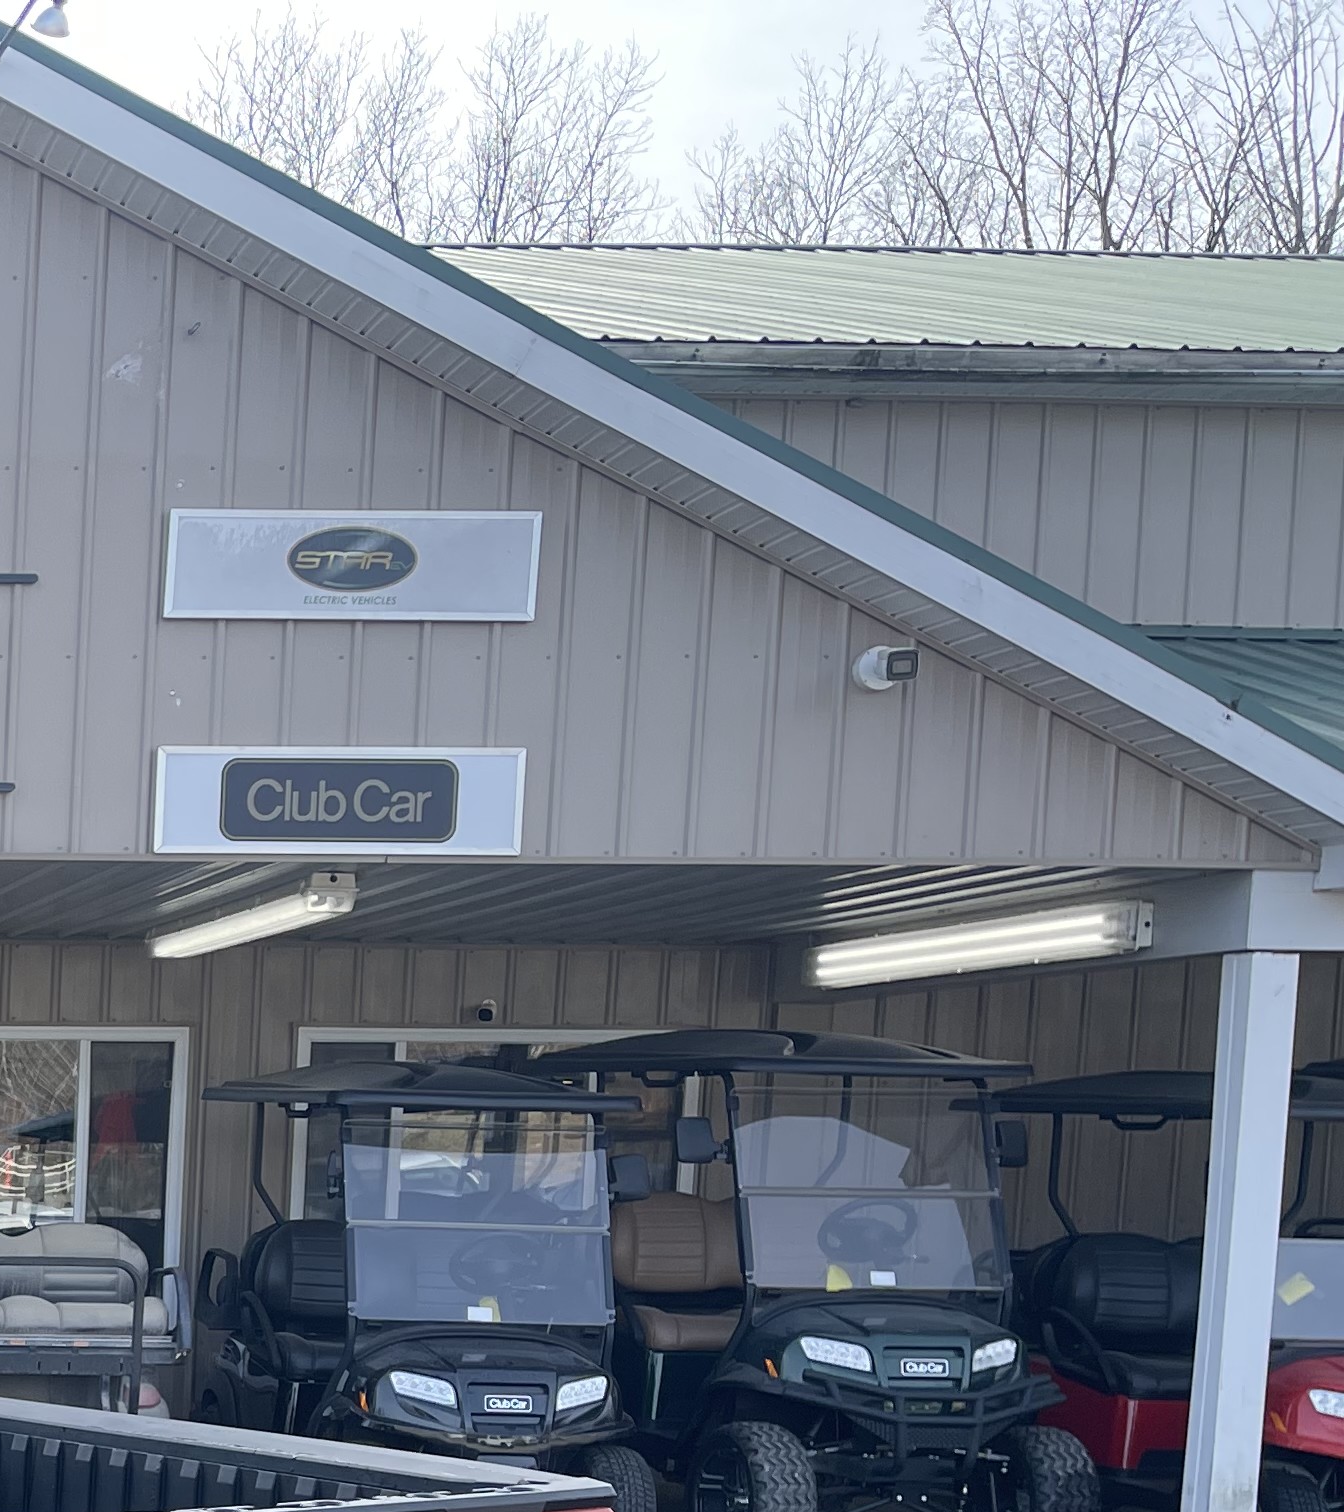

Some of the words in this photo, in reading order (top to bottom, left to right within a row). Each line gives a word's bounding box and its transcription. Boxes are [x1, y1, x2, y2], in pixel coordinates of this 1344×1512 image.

[303, 595, 347, 605] ELECTRIC
[351, 595, 397, 606] VEHICLES
[246, 778, 347, 823] Club
[353, 778, 433, 824] Car
